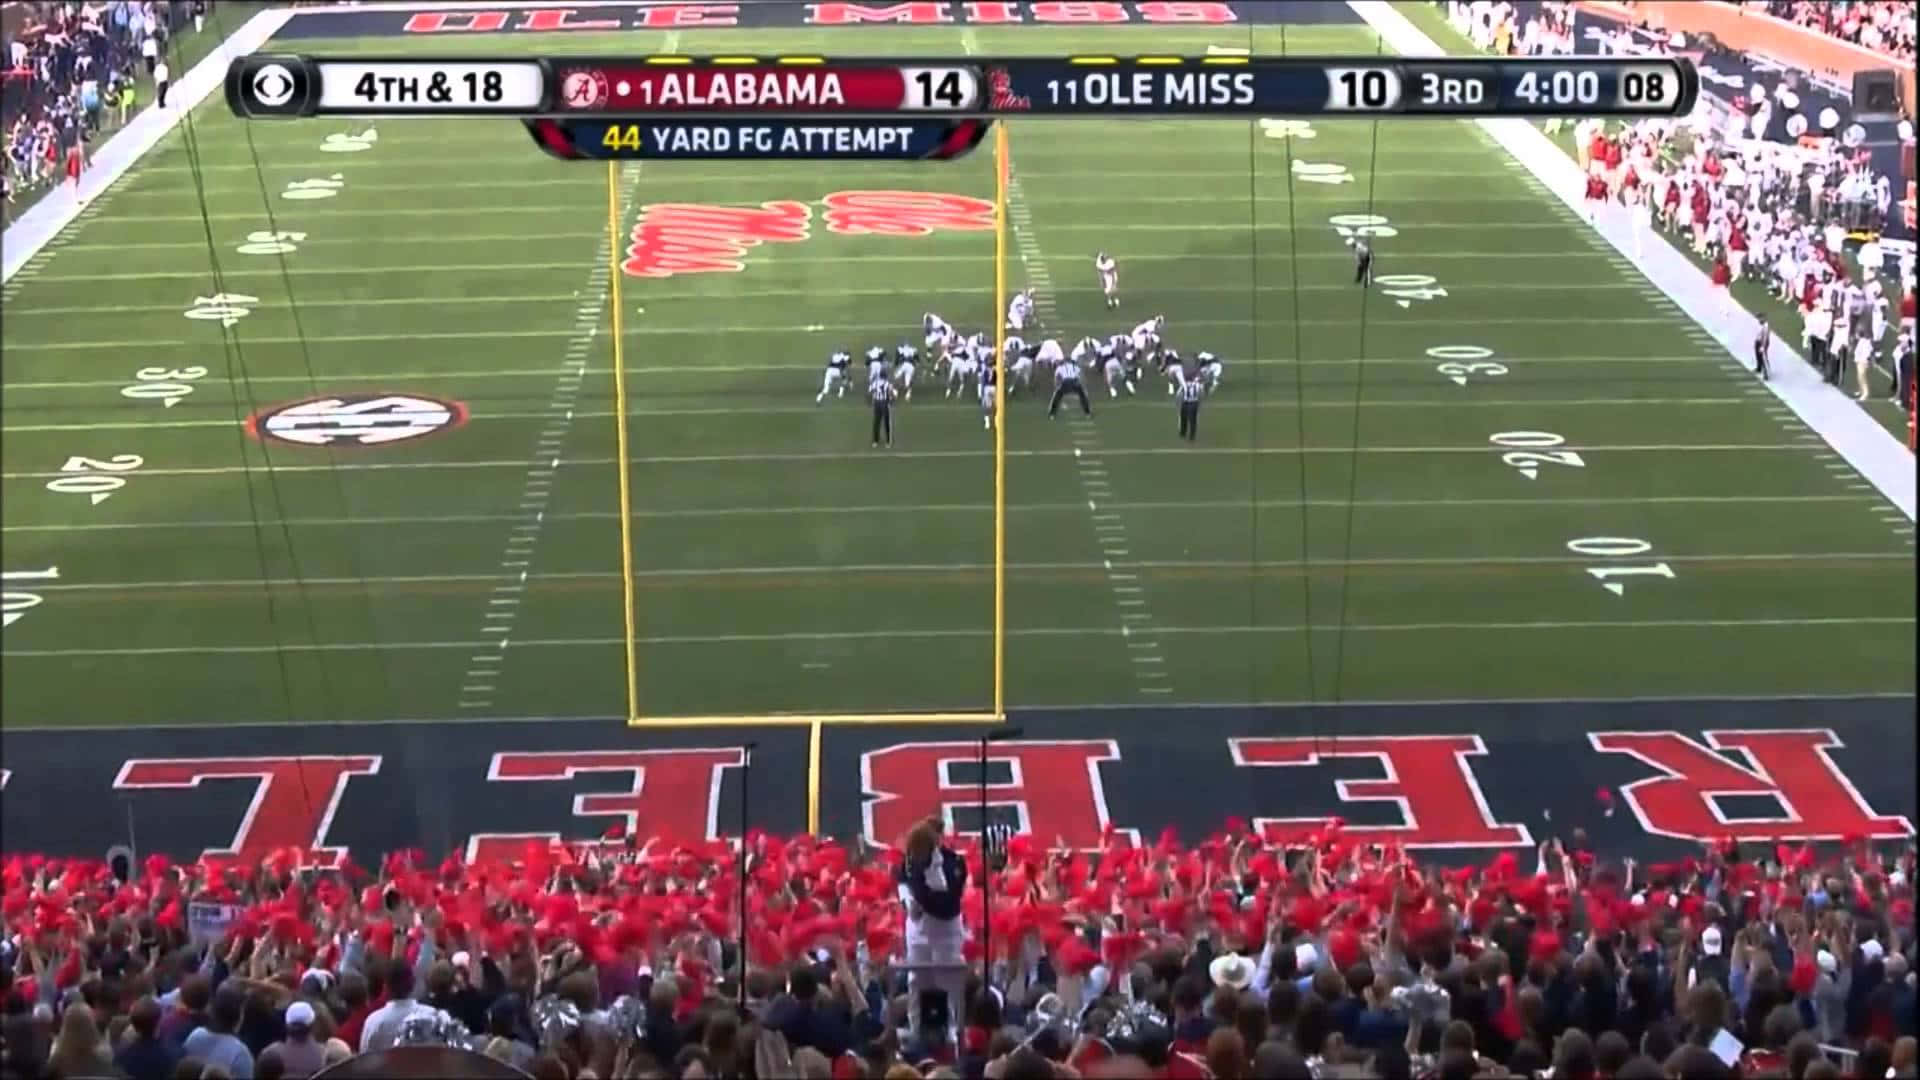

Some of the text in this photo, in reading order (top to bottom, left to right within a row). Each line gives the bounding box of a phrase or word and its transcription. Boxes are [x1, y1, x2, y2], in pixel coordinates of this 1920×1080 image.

[402, 0, 1238, 33] OLE MISS
[1374, 274, 1449, 300] 40
[184, 293, 260, 319] 40
[1426, 346, 1509, 375] 30
[121, 366, 208, 398] 30
[1489, 431, 1585, 467] 20
[46, 454, 144, 493] 20
[1567, 537, 1676, 579] 10
[0, 727, 1910, 872] REBEL
